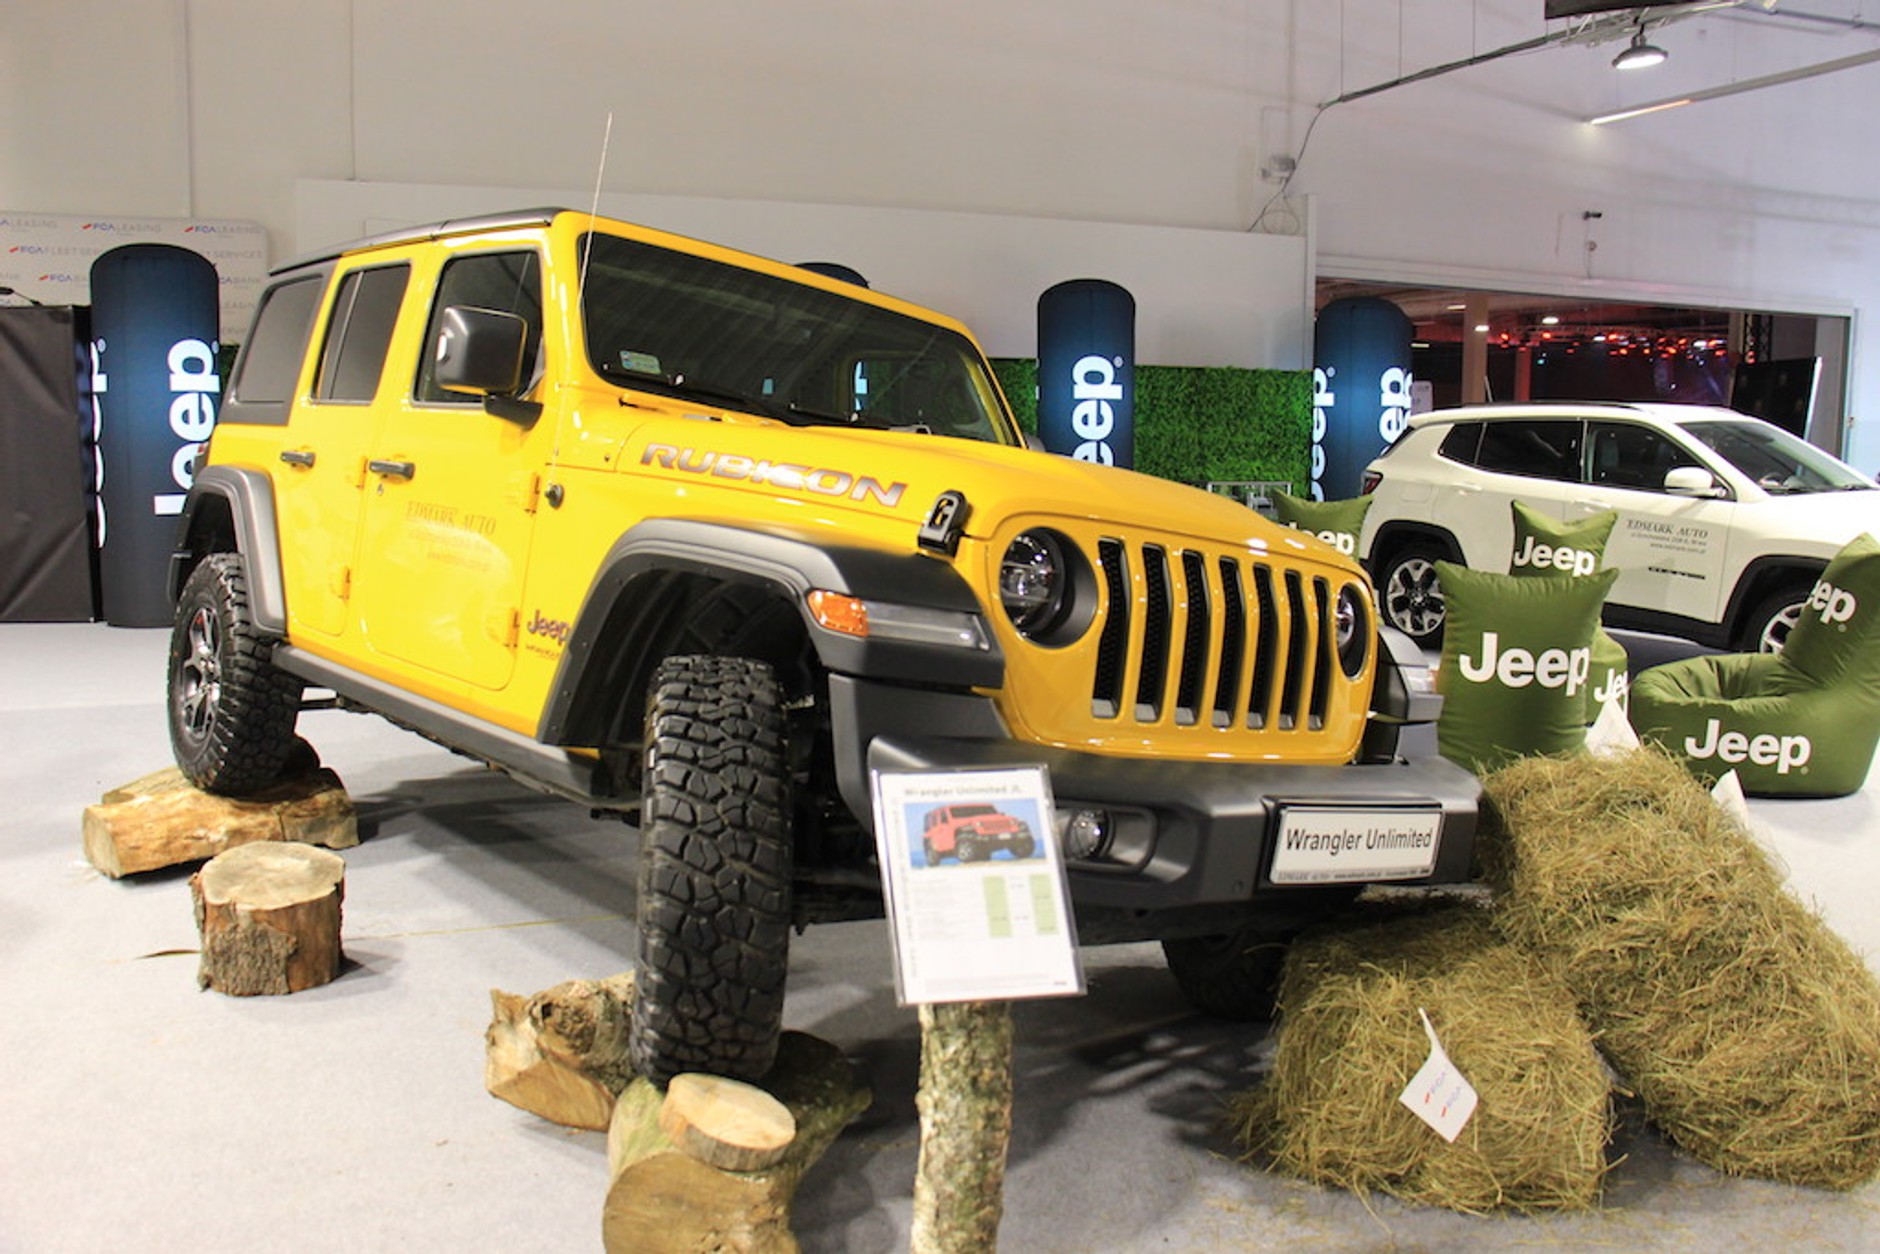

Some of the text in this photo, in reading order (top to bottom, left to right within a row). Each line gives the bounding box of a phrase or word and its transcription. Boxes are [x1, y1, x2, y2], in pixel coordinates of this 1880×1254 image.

[1072, 356, 1122, 467] eep
[640, 442, 908, 508] RUBICON
[462, 513, 497, 536] AUTO
[1677, 527, 1709, 539] AUTO
[1514, 536, 1595, 577] Jeep
[527, 609, 570, 647] Jeep
[1459, 632, 1590, 697] Jeep
[1685, 718, 1811, 774] Jeep
[1286, 827, 1433, 856] Wrangler Unlimited
